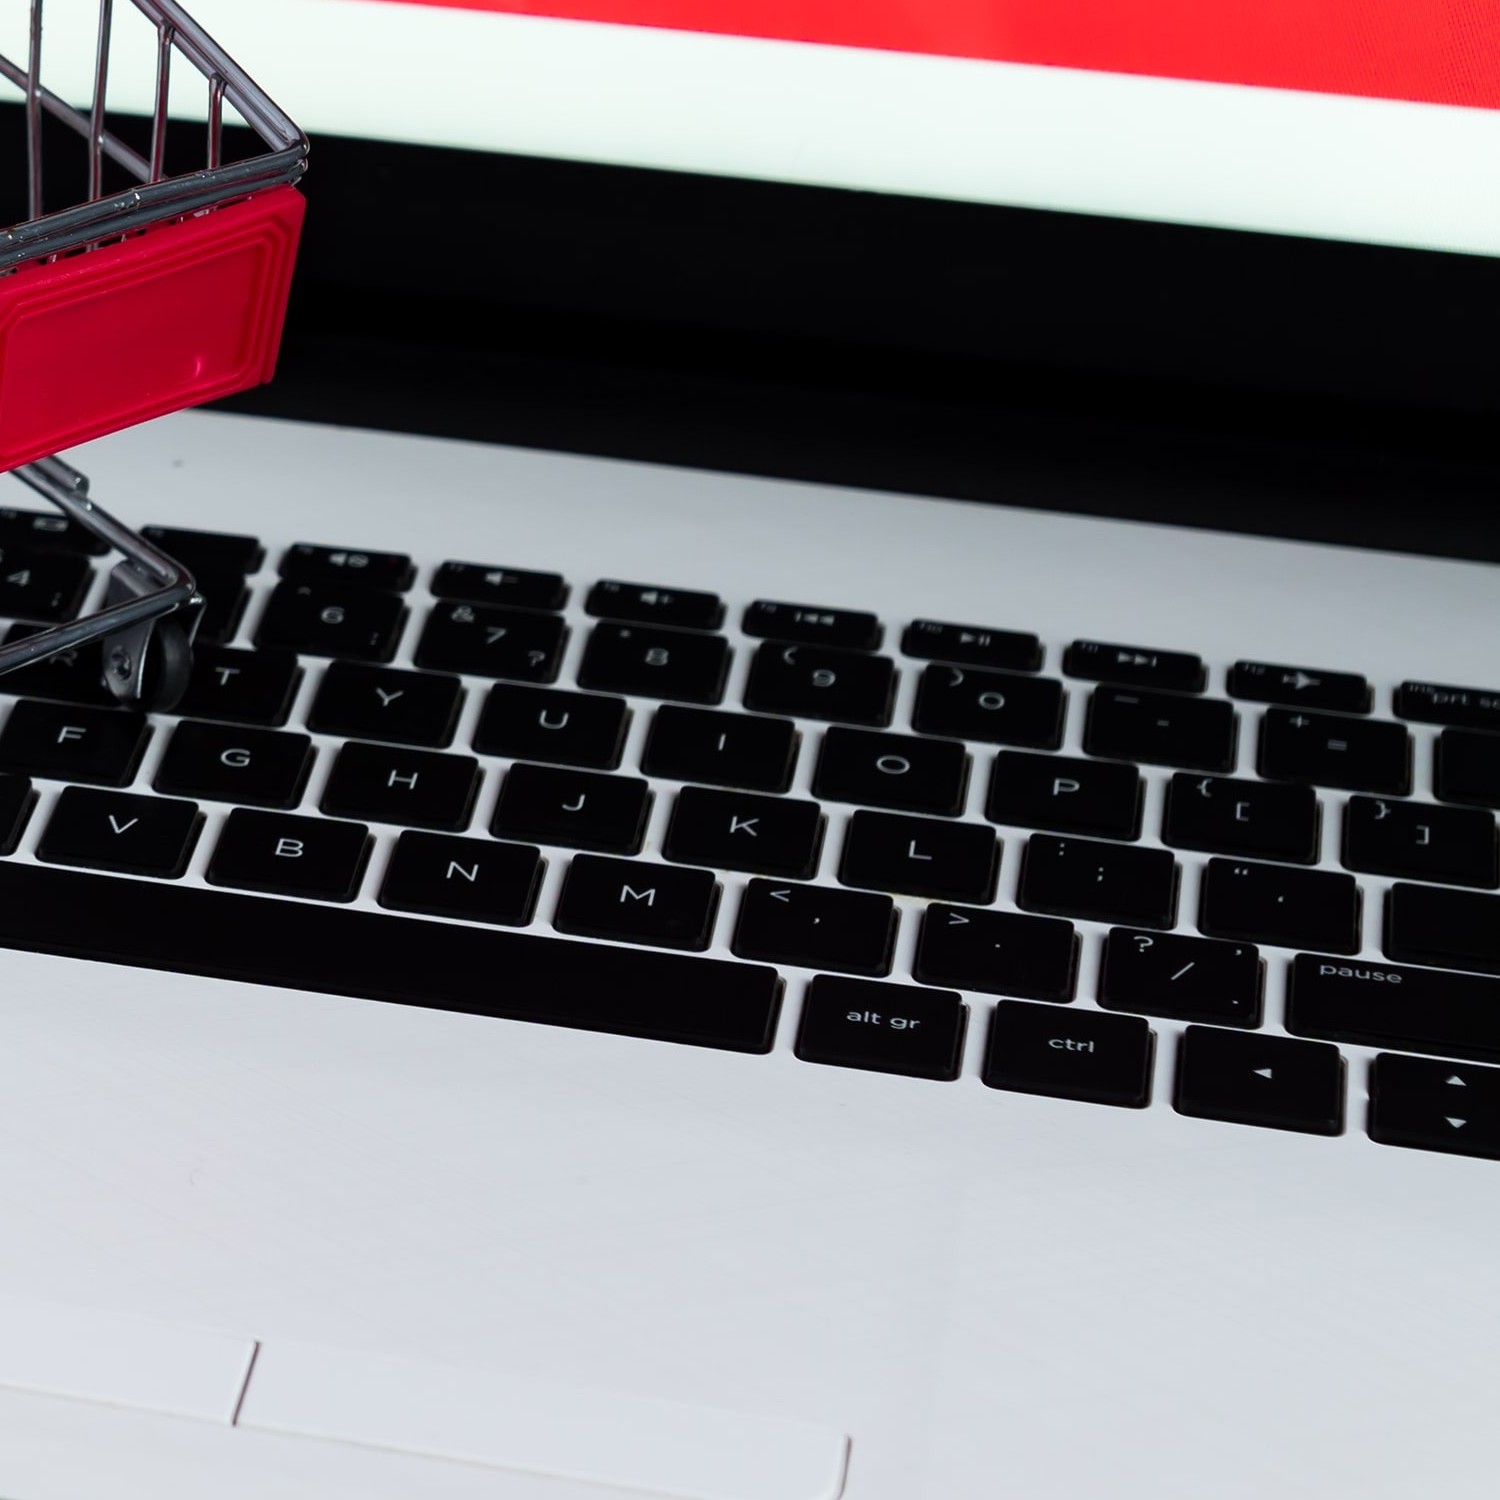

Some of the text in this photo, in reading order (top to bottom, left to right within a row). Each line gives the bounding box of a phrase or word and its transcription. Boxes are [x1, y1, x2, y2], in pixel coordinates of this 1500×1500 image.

[7, 570, 30, 586] 4
[320, 606, 344, 624] 6
[487, 627, 507, 644] 7
[50, 649, 79, 668] R
[644, 648, 669, 666] 8
[216, 667, 239, 686] T
[812, 669, 836, 687] 9
[375, 687, 404, 707] Y
[978, 692, 1006, 710] 0
[539, 709, 569, 730] U
[57, 726, 86, 744] F
[718, 733, 726, 751] I
[220, 748, 251, 767] G
[875, 755, 911, 775] O
[387, 769, 419, 790] H
[1052, 778, 1080, 796] P
[562, 794, 586, 811] J
[108, 814, 139, 834] V
[729, 815, 759, 837] K
[274, 837, 304, 858] B
[908, 839, 932, 861] L
[446, 860, 479, 882] N
[619, 884, 656, 907] M
[1320, 963, 1402, 984] pause
[846, 1010, 921, 1030] alt gr
[1048, 1038, 1095, 1053] ctrl
